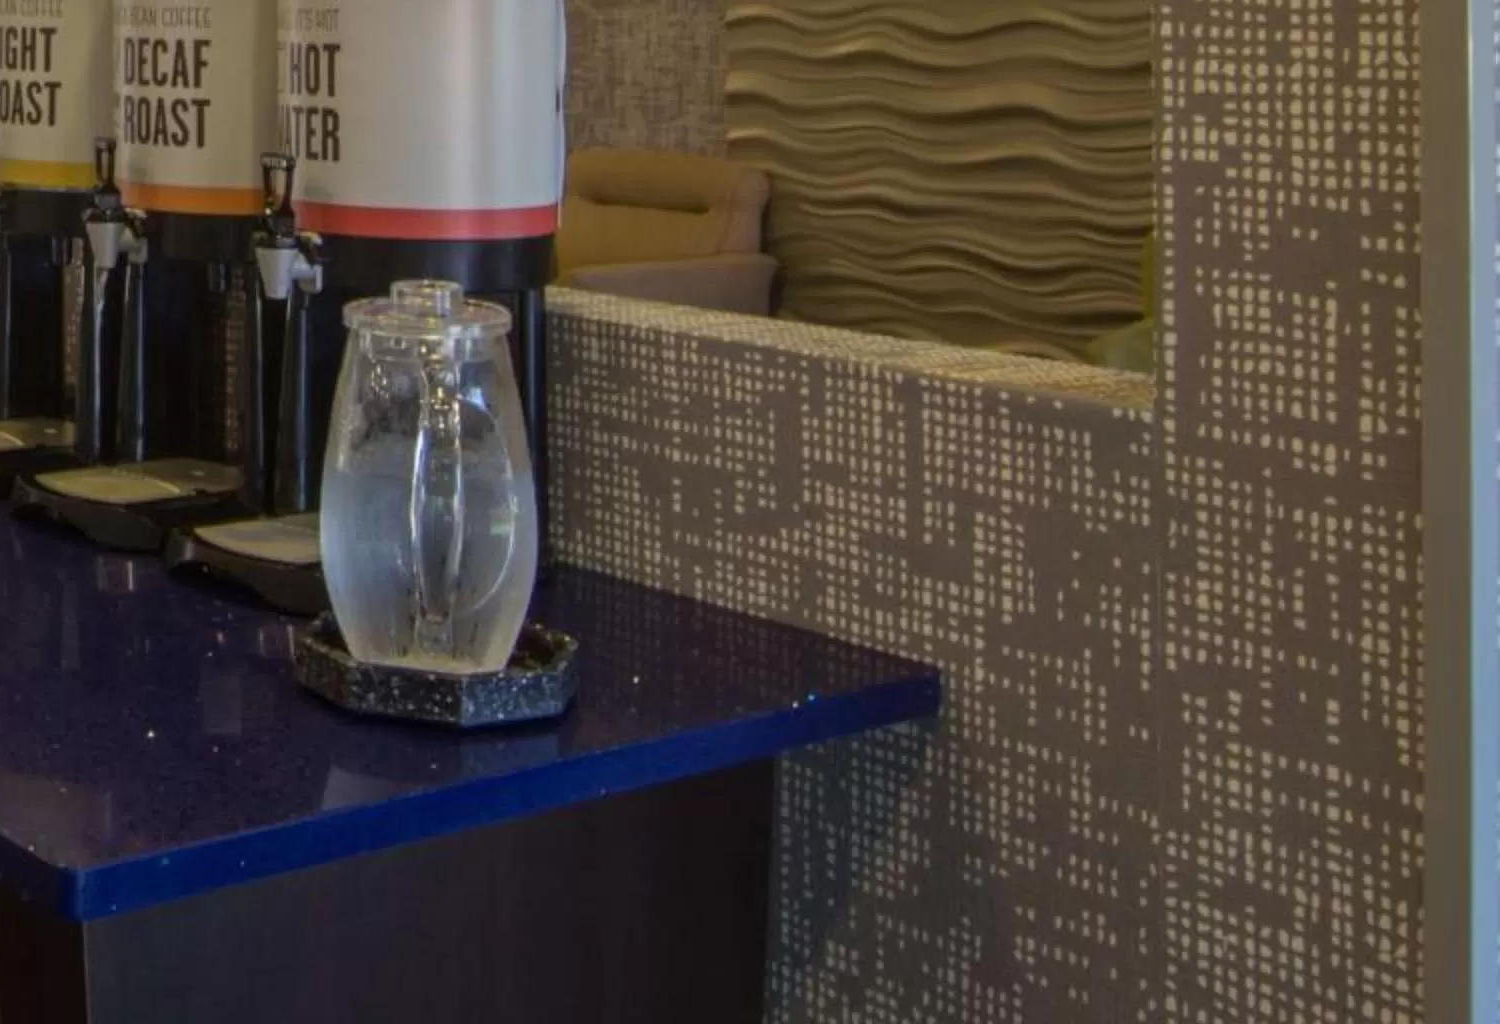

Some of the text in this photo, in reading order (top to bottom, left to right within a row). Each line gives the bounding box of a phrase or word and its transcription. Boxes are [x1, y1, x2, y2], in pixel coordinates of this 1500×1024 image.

[160, 7, 213, 29] COFFEE
[124, 37, 213, 88] DECAF
[289, 42, 341, 98] HOT
[124, 95, 212, 149] ROAST
[278, 104, 341, 163] ATER
